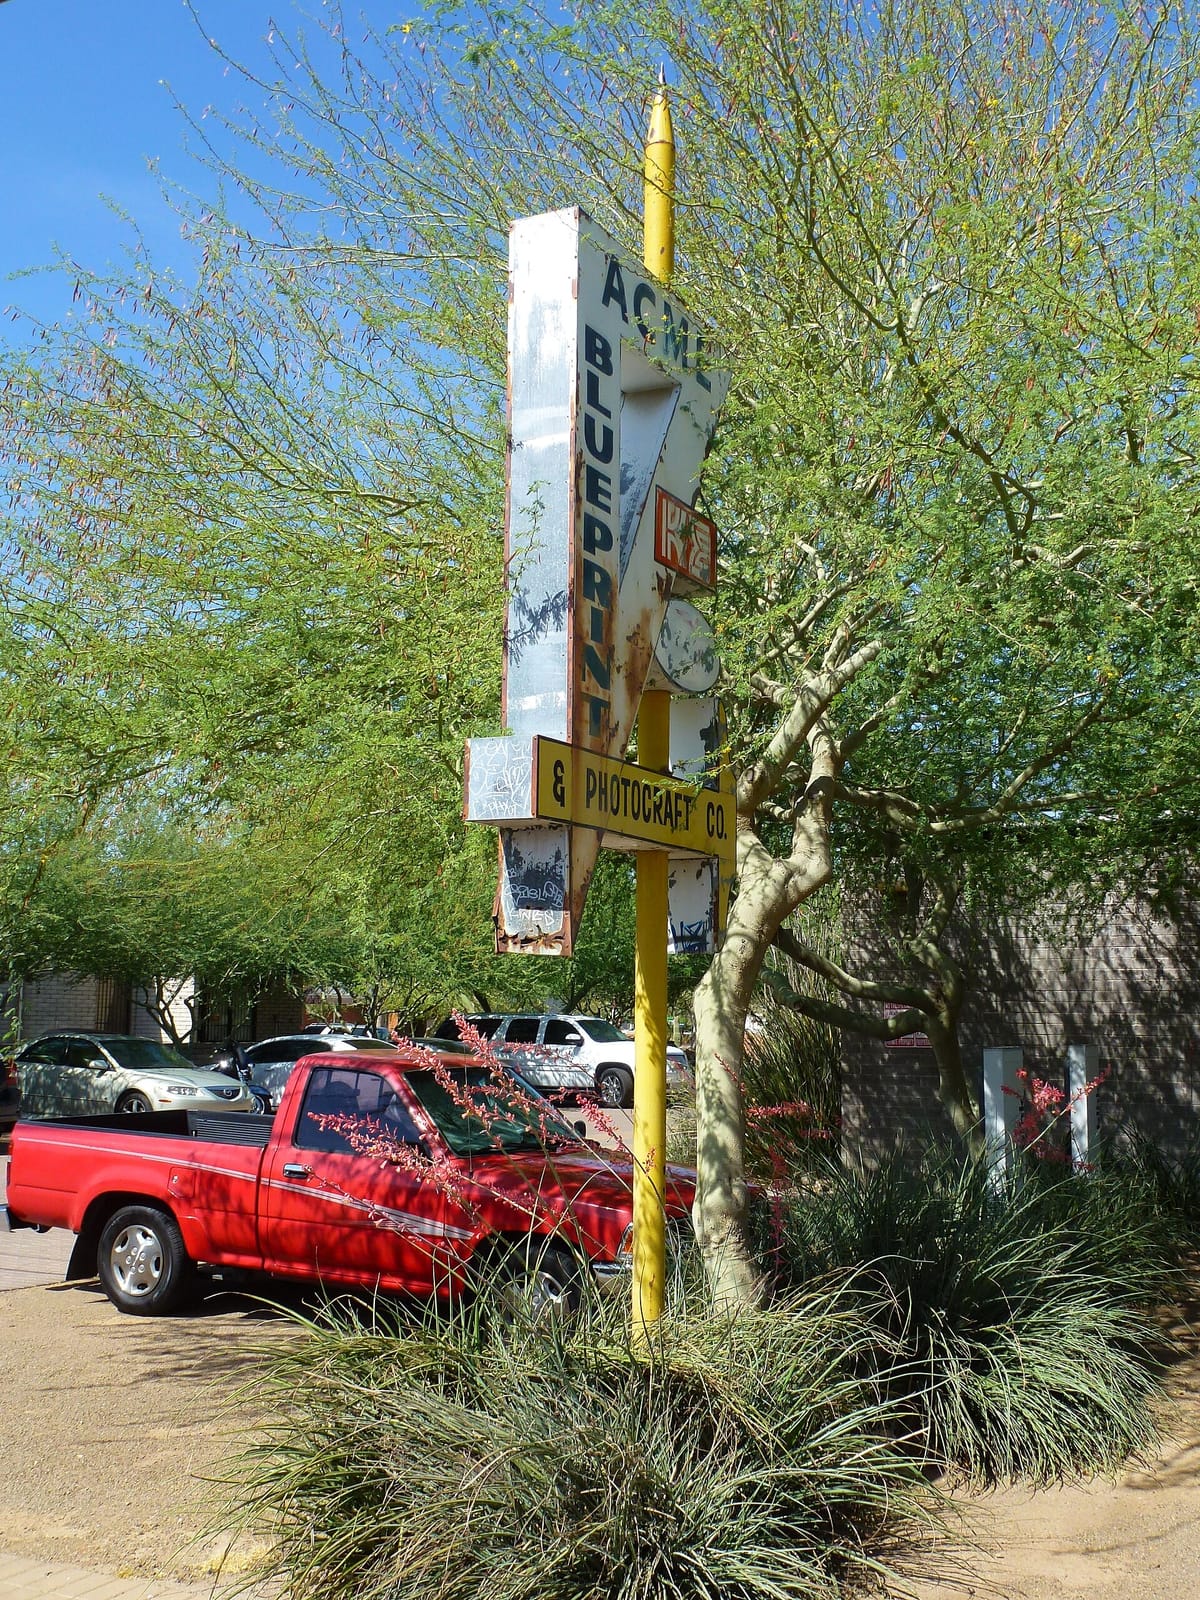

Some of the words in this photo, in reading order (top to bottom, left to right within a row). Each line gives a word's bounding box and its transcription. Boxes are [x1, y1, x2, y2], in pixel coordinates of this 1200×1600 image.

[581, 323, 614, 737] BLUEPRINT
[553, 759, 565, 808] &
[586, 767, 696, 831] PHOTOCRAFT
[706, 801, 727, 840] CO.
